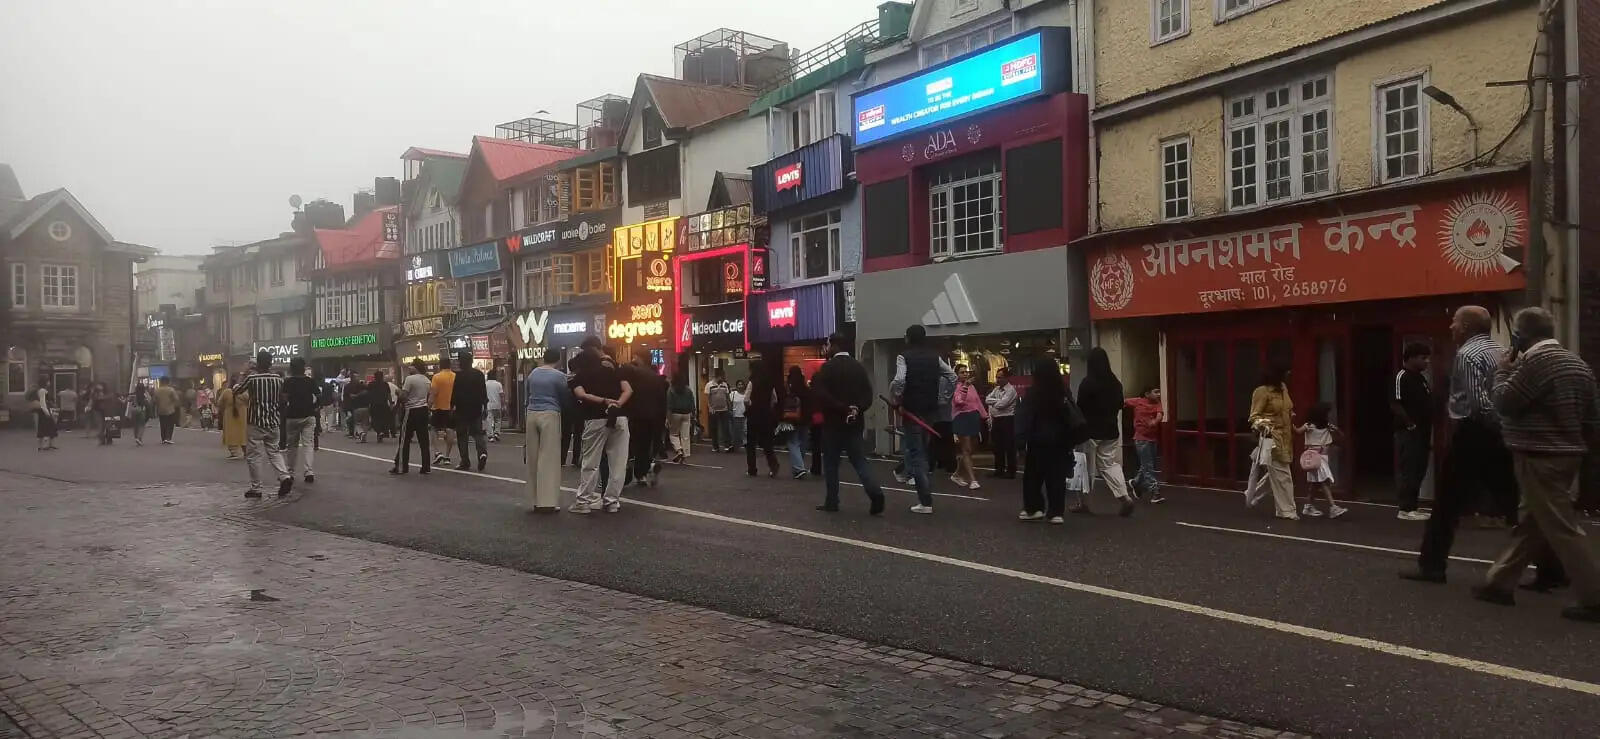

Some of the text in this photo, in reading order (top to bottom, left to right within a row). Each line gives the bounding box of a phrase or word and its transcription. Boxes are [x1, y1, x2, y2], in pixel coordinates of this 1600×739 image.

[926, 129, 956, 152] ADA
[588, 223, 606, 234] bake
[523, 230, 556, 247] WILDCRAFT
[1239, 263, 1296, 285] माल रोड
[1282, 278, 1347, 298] 2658976
[631, 303, 662, 320] xero
[608, 320, 663, 344] degrees
[691, 320, 721, 335] Hideout
